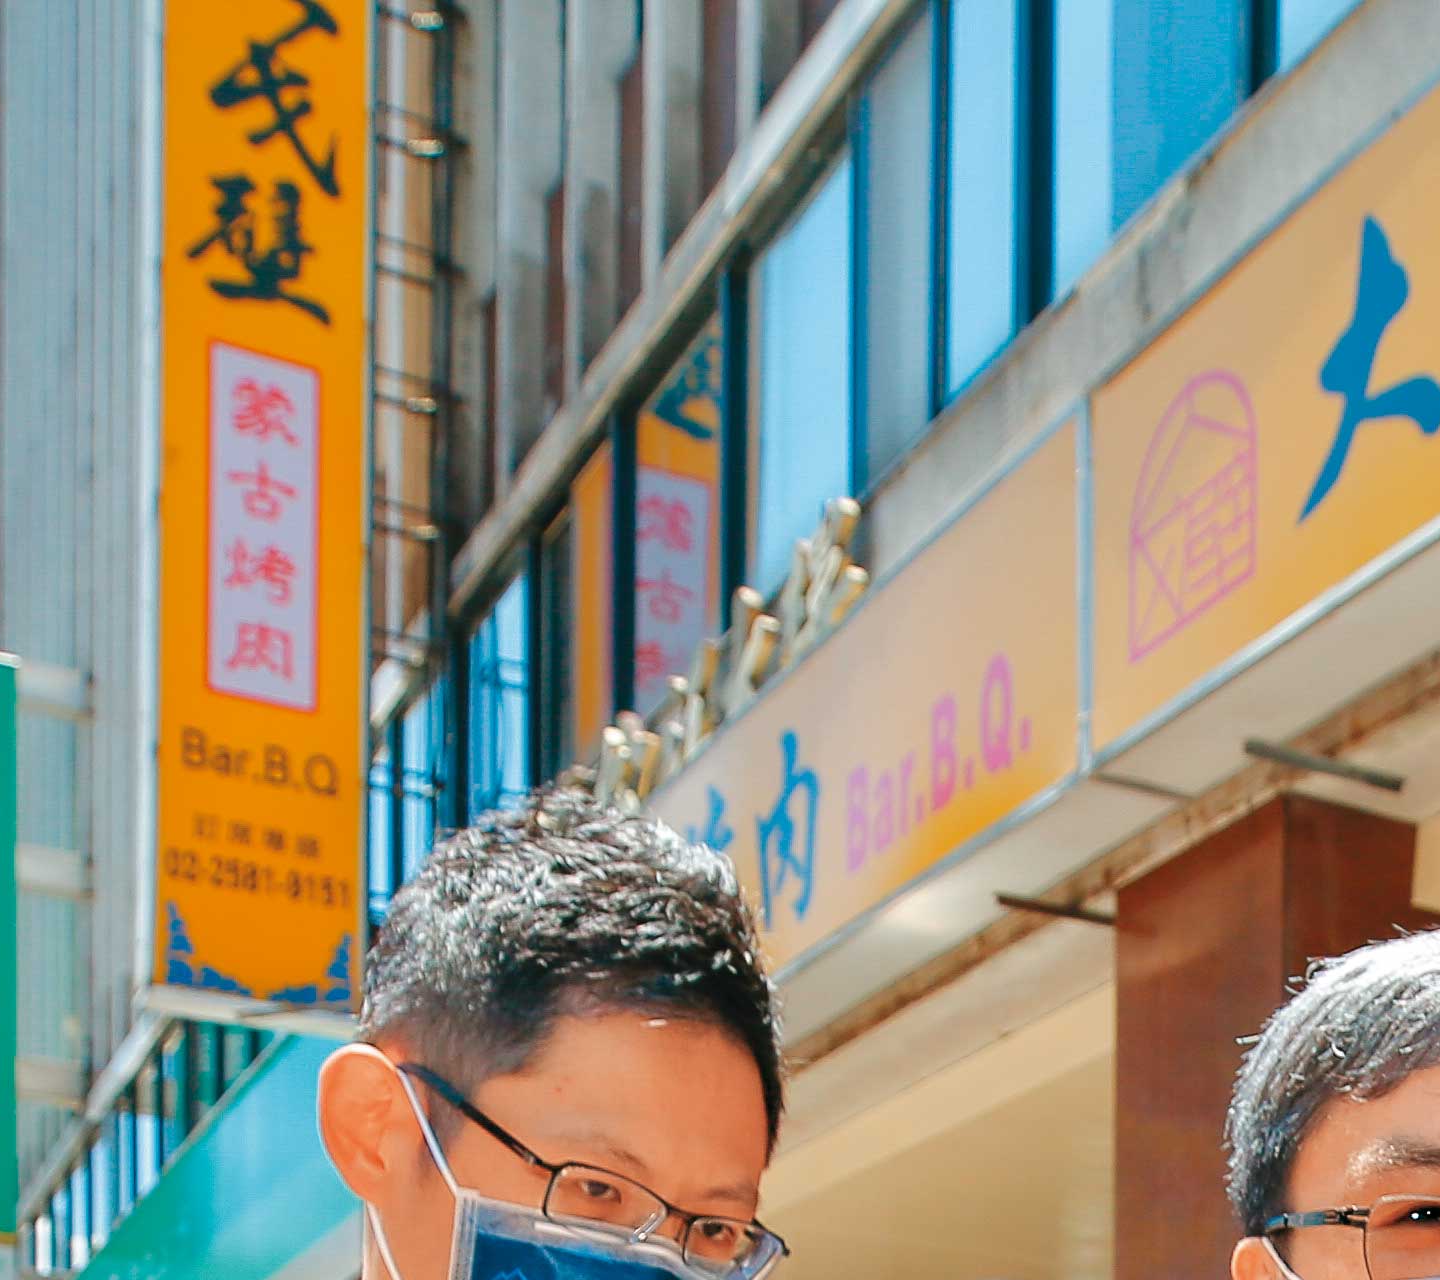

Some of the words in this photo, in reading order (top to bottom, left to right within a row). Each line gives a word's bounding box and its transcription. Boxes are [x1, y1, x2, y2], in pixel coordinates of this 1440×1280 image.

[186, 0, 340, 326] 戈壁
[224, 376, 301, 682] 蒙古烤肉
[180, 726, 340, 798] Bar.B.Q
